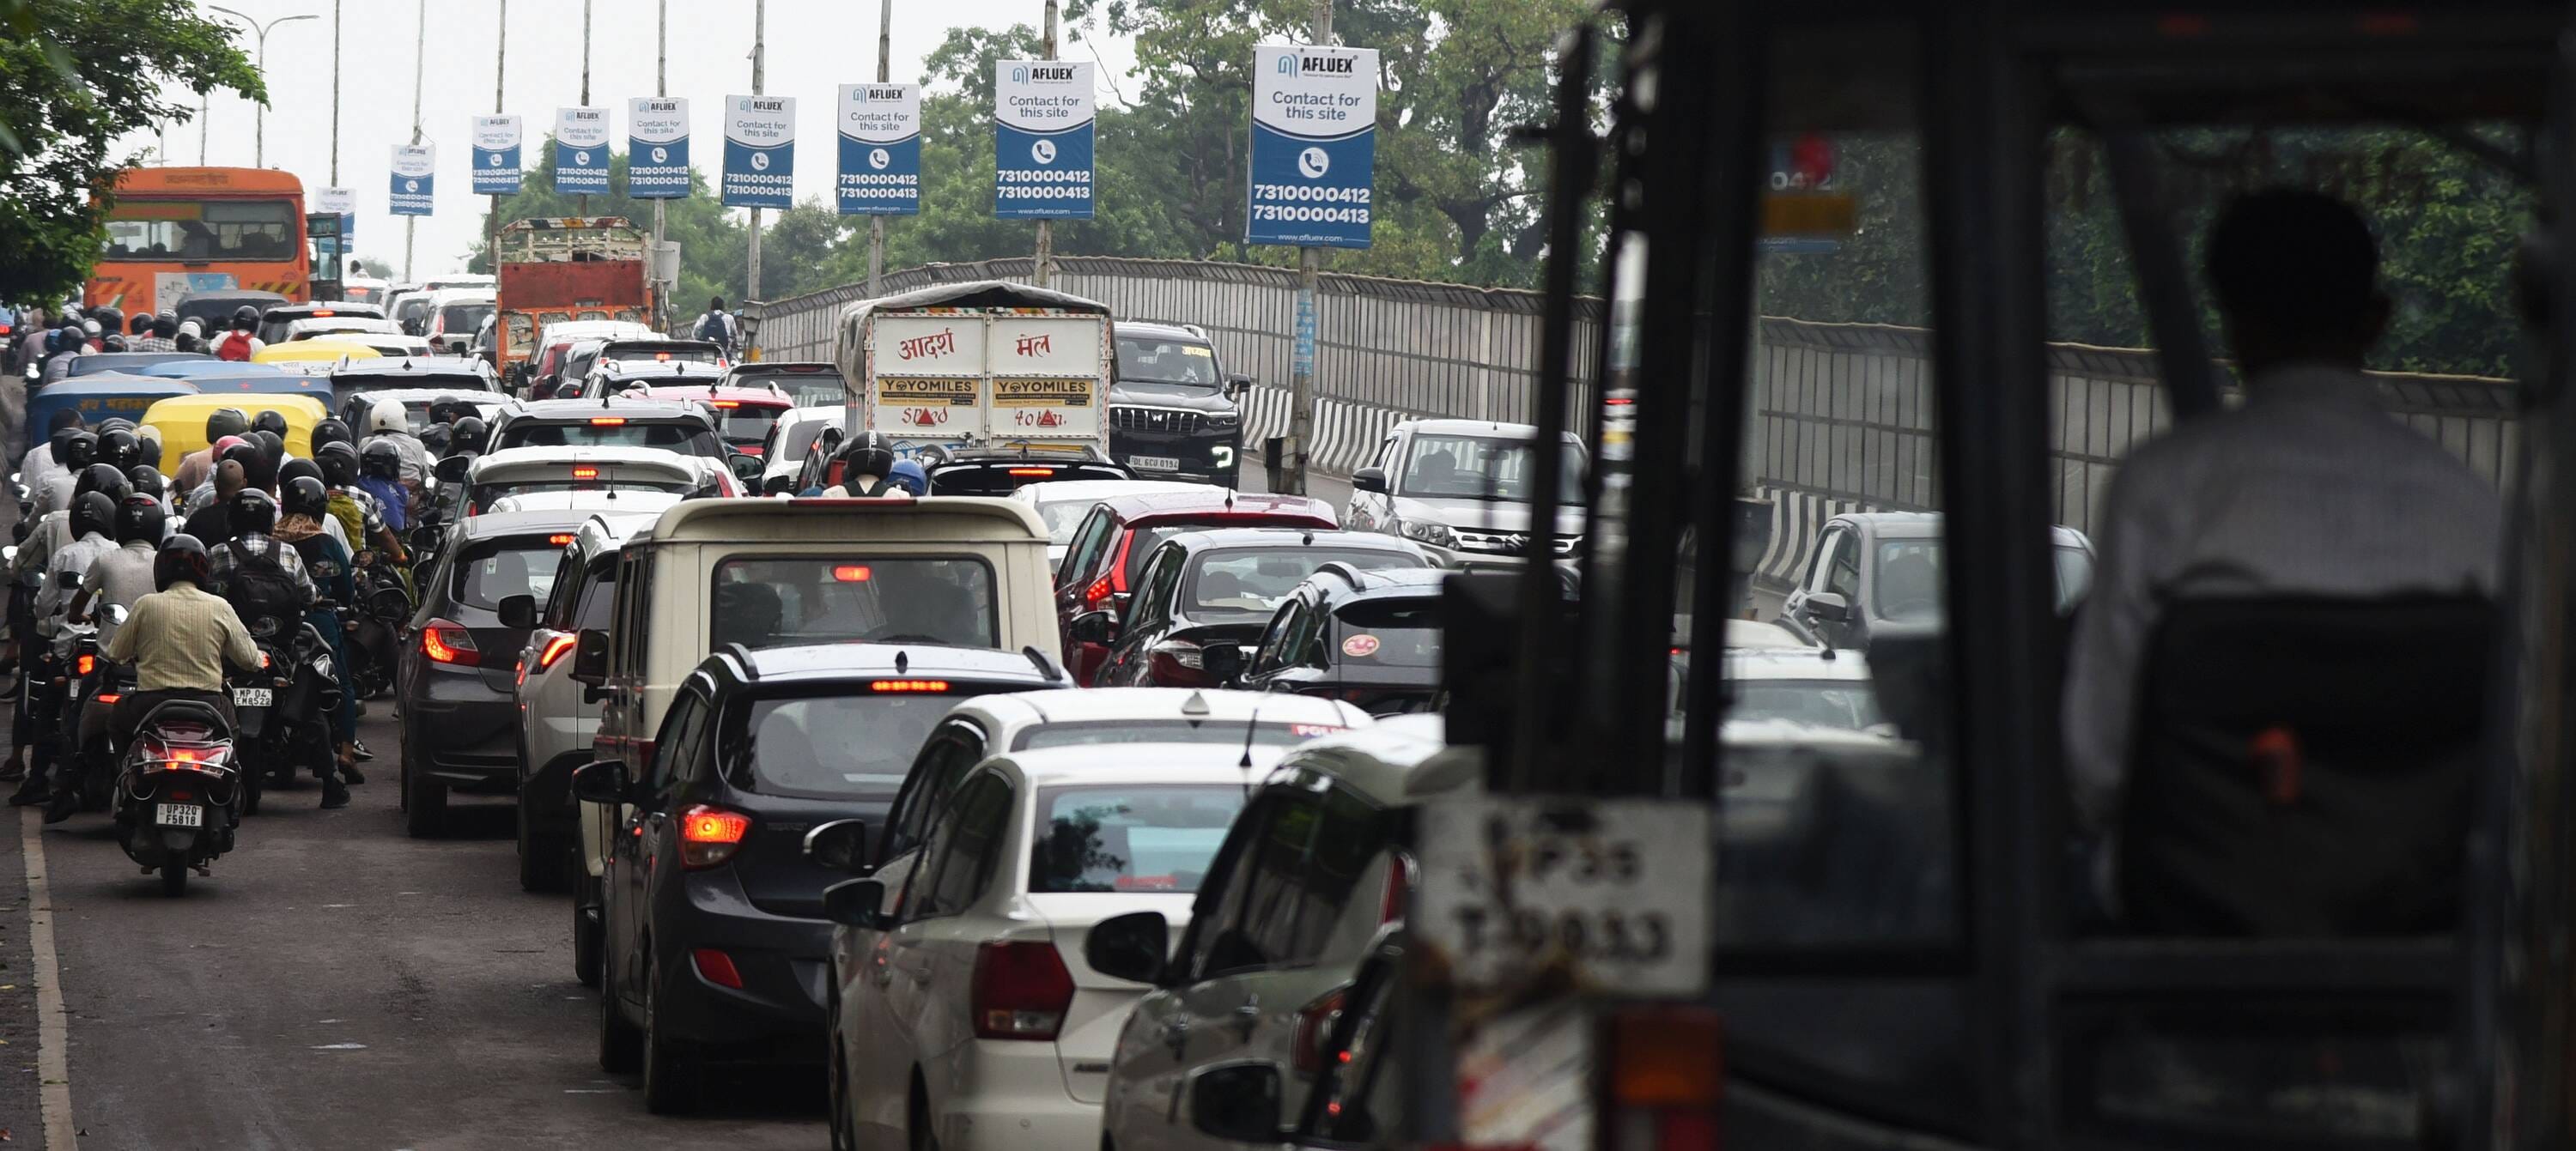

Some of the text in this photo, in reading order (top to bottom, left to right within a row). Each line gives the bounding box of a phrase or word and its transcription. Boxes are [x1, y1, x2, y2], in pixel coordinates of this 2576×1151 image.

[1302, 57, 1352, 73] AFLUEX
[1032, 68, 1072, 80] AFLUEX
[869, 89, 902, 100] AFLUEX
[1273, 91, 1361, 107] Contact for
[651, 102, 676, 111] AFLUEX
[753, 101, 782, 111] AFLUEX
[1009, 96, 1080, 106] Contact for
[850, 112, 909, 122] Contact for
[1020, 107, 1069, 118] this site
[1286, 106, 1346, 121] this site
[737, 120, 787, 130] Contact for
[860, 121, 900, 131] this site
[744, 129, 761, 137] this
[629, 167, 689, 175] 7310000412
[997, 170, 1091, 183] 7310000412
[629, 176, 689, 185] 7310000413
[726, 173, 793, 185] 7310000412
[840, 174, 918, 185] 7310000412
[726, 185, 792, 197] 7310000413
[840, 188, 918, 198] 7310000413
[997, 186, 1091, 199] 7310000413
[1254, 185, 1370, 204] 7310000412
[1253, 204, 1370, 224] 7310000413
[1278, 233, 1343, 243] www.afluex.com
[898, 327, 955, 360] आदर्श
[166, 815, 196, 825] F5818
